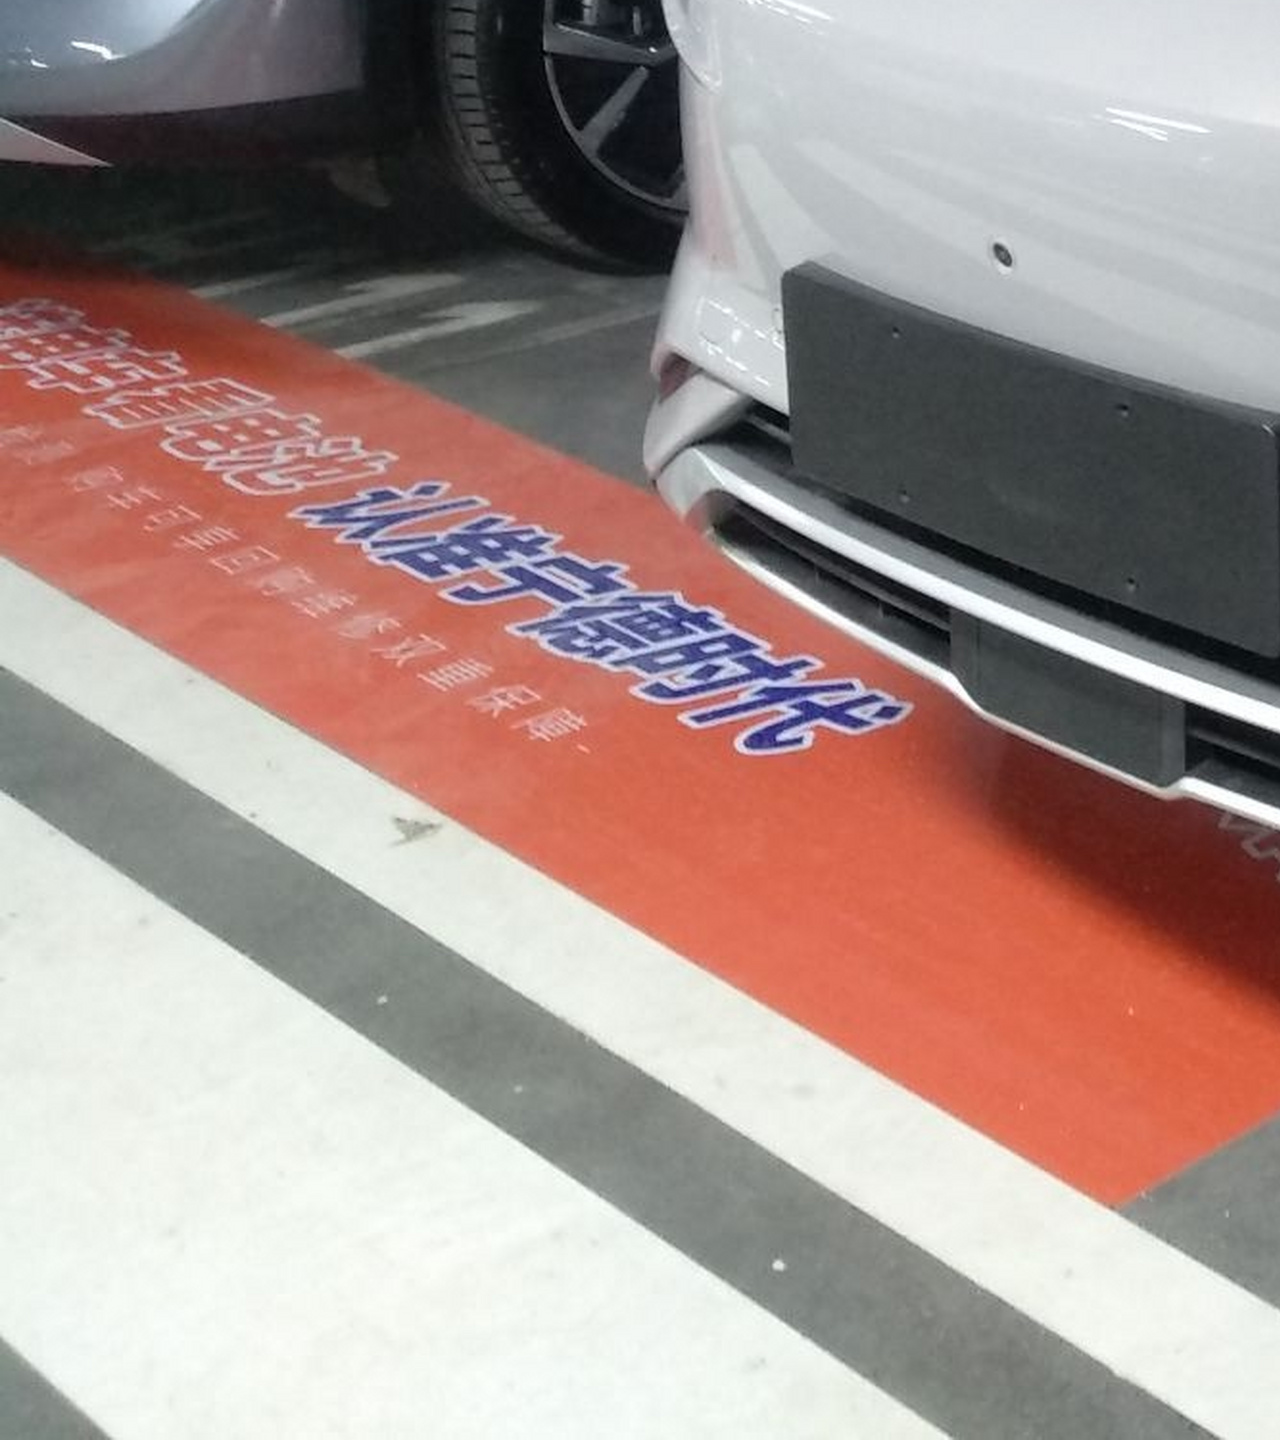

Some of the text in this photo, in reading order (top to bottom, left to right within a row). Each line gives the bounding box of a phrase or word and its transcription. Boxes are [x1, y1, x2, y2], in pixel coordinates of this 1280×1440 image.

[289, 480, 914, 757] 认准宁德时代
